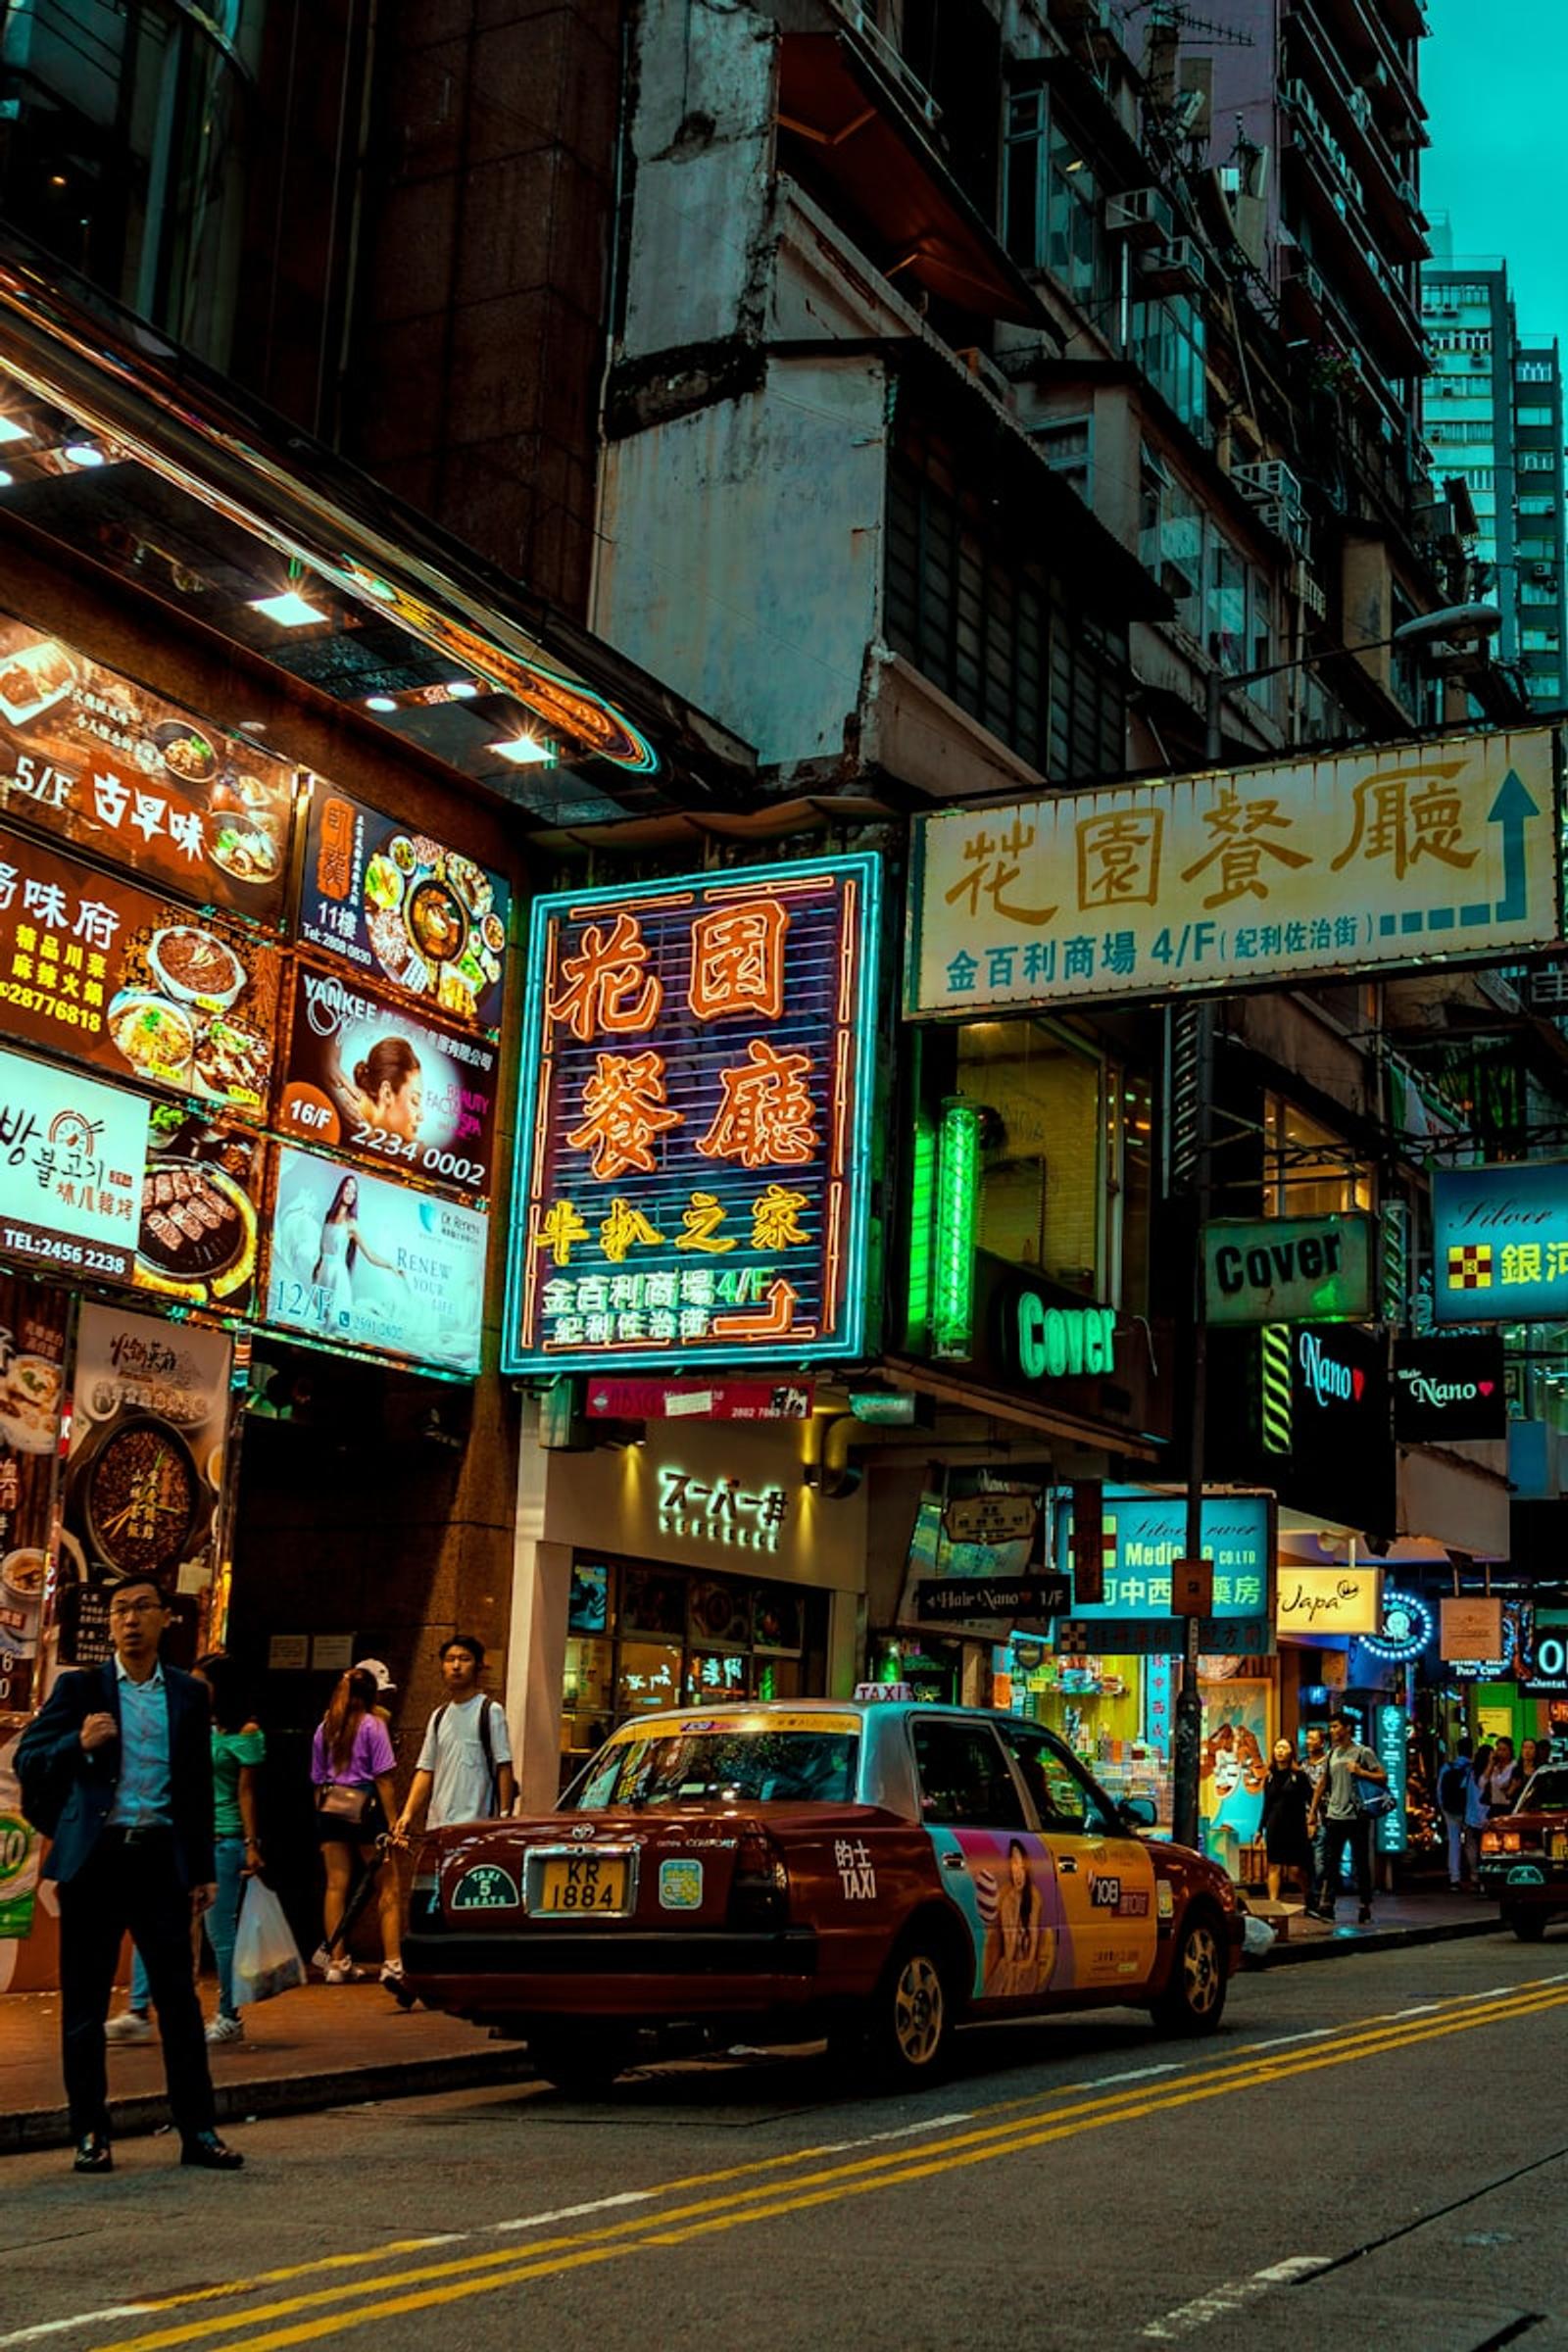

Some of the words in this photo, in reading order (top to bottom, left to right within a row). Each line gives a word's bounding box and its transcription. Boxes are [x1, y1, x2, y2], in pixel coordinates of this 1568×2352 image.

[14, 756, 74, 808] 5/F
[93, 771, 204, 862] 古早味
[945, 760, 1482, 926] 花園餐廳
[550, 899, 789, 1042] 花園
[946, 930, 1137, 994] 金百利商場
[1152, 920, 1218, 965] 4/F
[303, 974, 378, 1022] YANKEE
[289, 1099, 332, 1129] 16/F
[566, 1041, 820, 1180] 餐廳
[350, 1121, 417, 1161] 2234
[421, 1148, 486, 1186] 0002
[534, 1185, 812, 1267] 牛扒之家
[1447, 1199, 1552, 1230] Silver
[85, 1250, 125, 1274] 2238
[1215, 1230, 1342, 1294] Cover
[275, 1280, 334, 1322] 12/F
[1017, 1291, 1116, 1378] Cover
[1299, 1331, 1352, 1407] Nano
[1409, 1378, 1477, 1408] Nano
[1125, 1542, 1213, 1567] Medice
[1040, 1589, 1065, 1607] 1/F
[858, 1685, 903, 1701] TAXI
[834, 1838, 872, 1869] 的士
[471, 1870, 502, 1884] TAXI
[479, 1880, 491, 1897] 5
[566, 1860, 600, 1885] KR
[839, 1868, 877, 1899] TAXI
[553, 1884, 613, 1909] 1884
